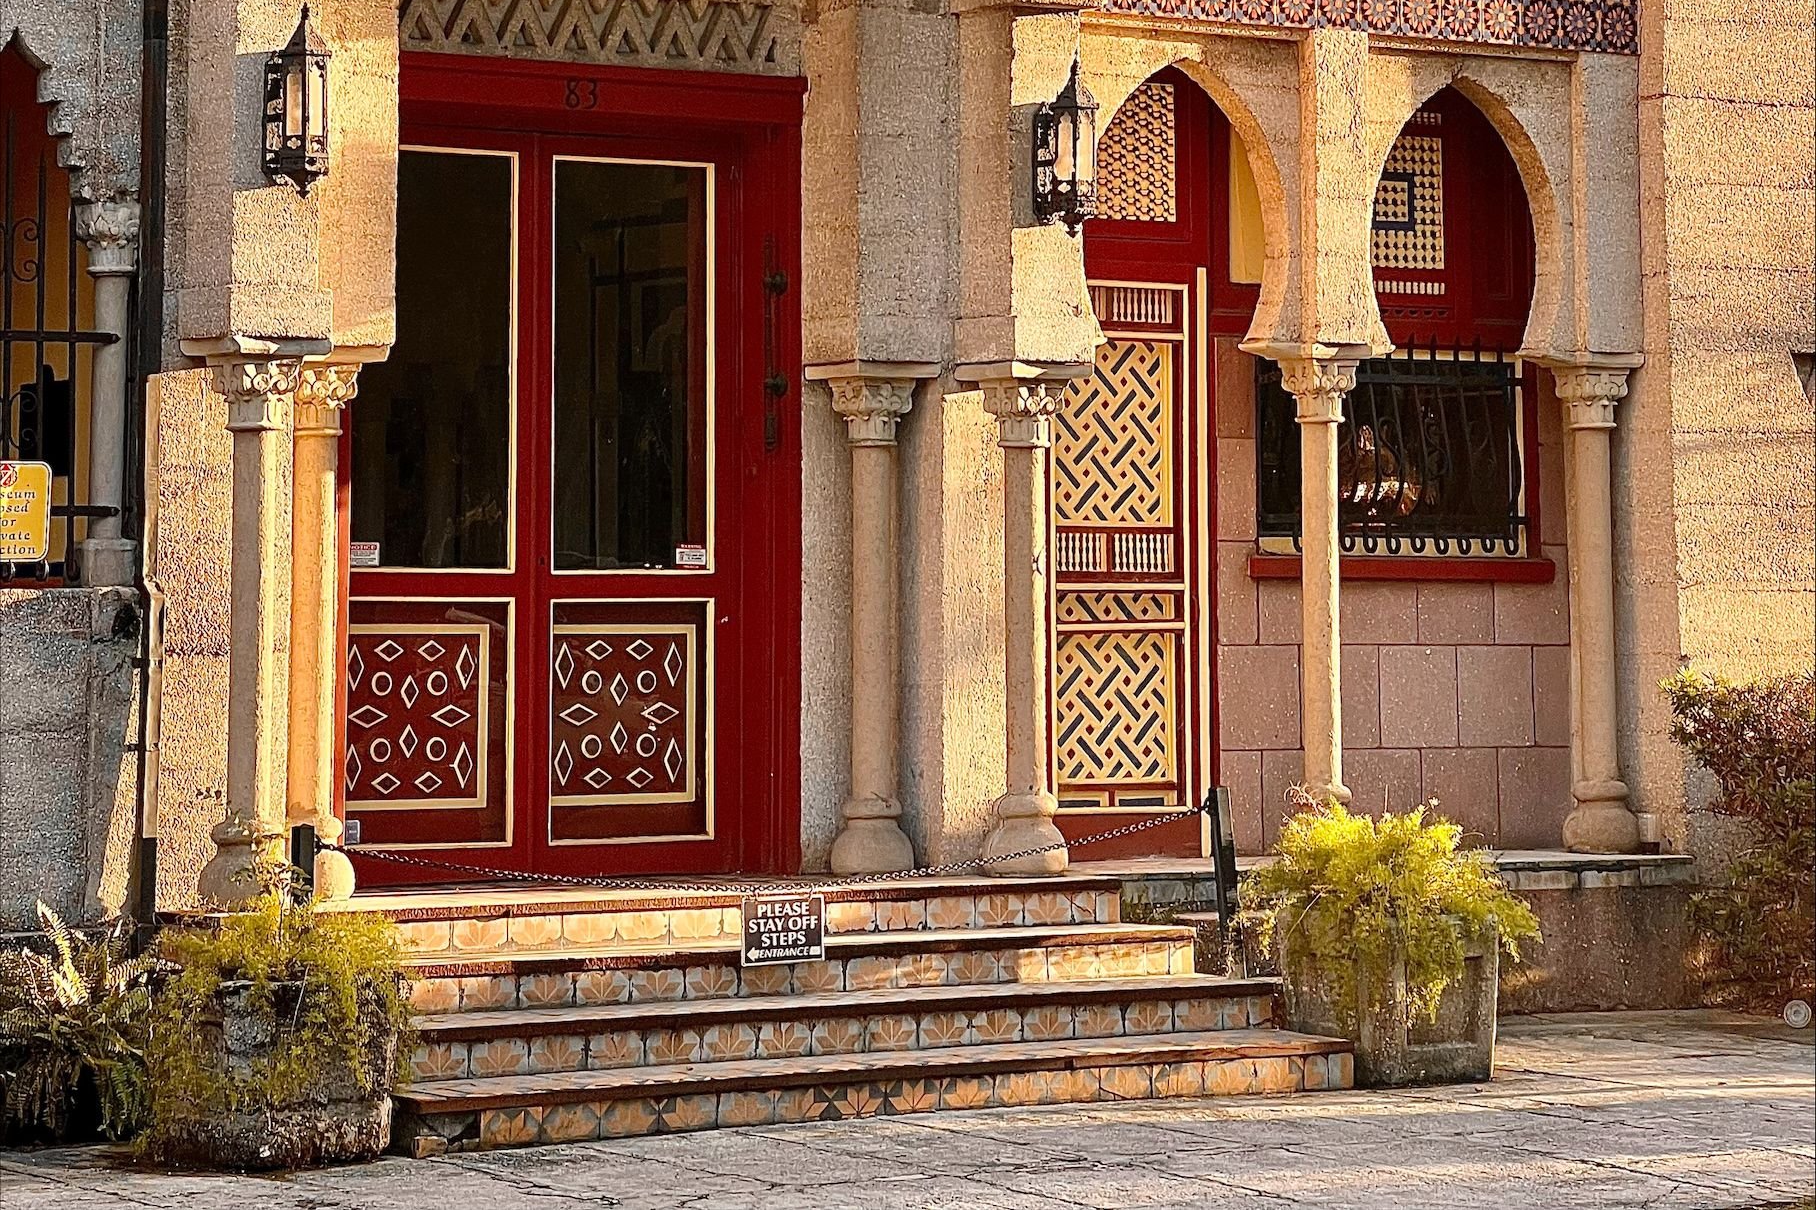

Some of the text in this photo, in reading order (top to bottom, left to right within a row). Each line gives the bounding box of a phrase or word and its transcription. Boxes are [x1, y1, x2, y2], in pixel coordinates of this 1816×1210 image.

[565, 77, 597, 109] 83
[0, 518, 16, 526] or
[757, 902, 809, 917] PLEASE
[749, 916, 818, 933] STAY OFF
[761, 931, 806, 947] STEPS
[759, 946, 809, 958] ENTRANCE
